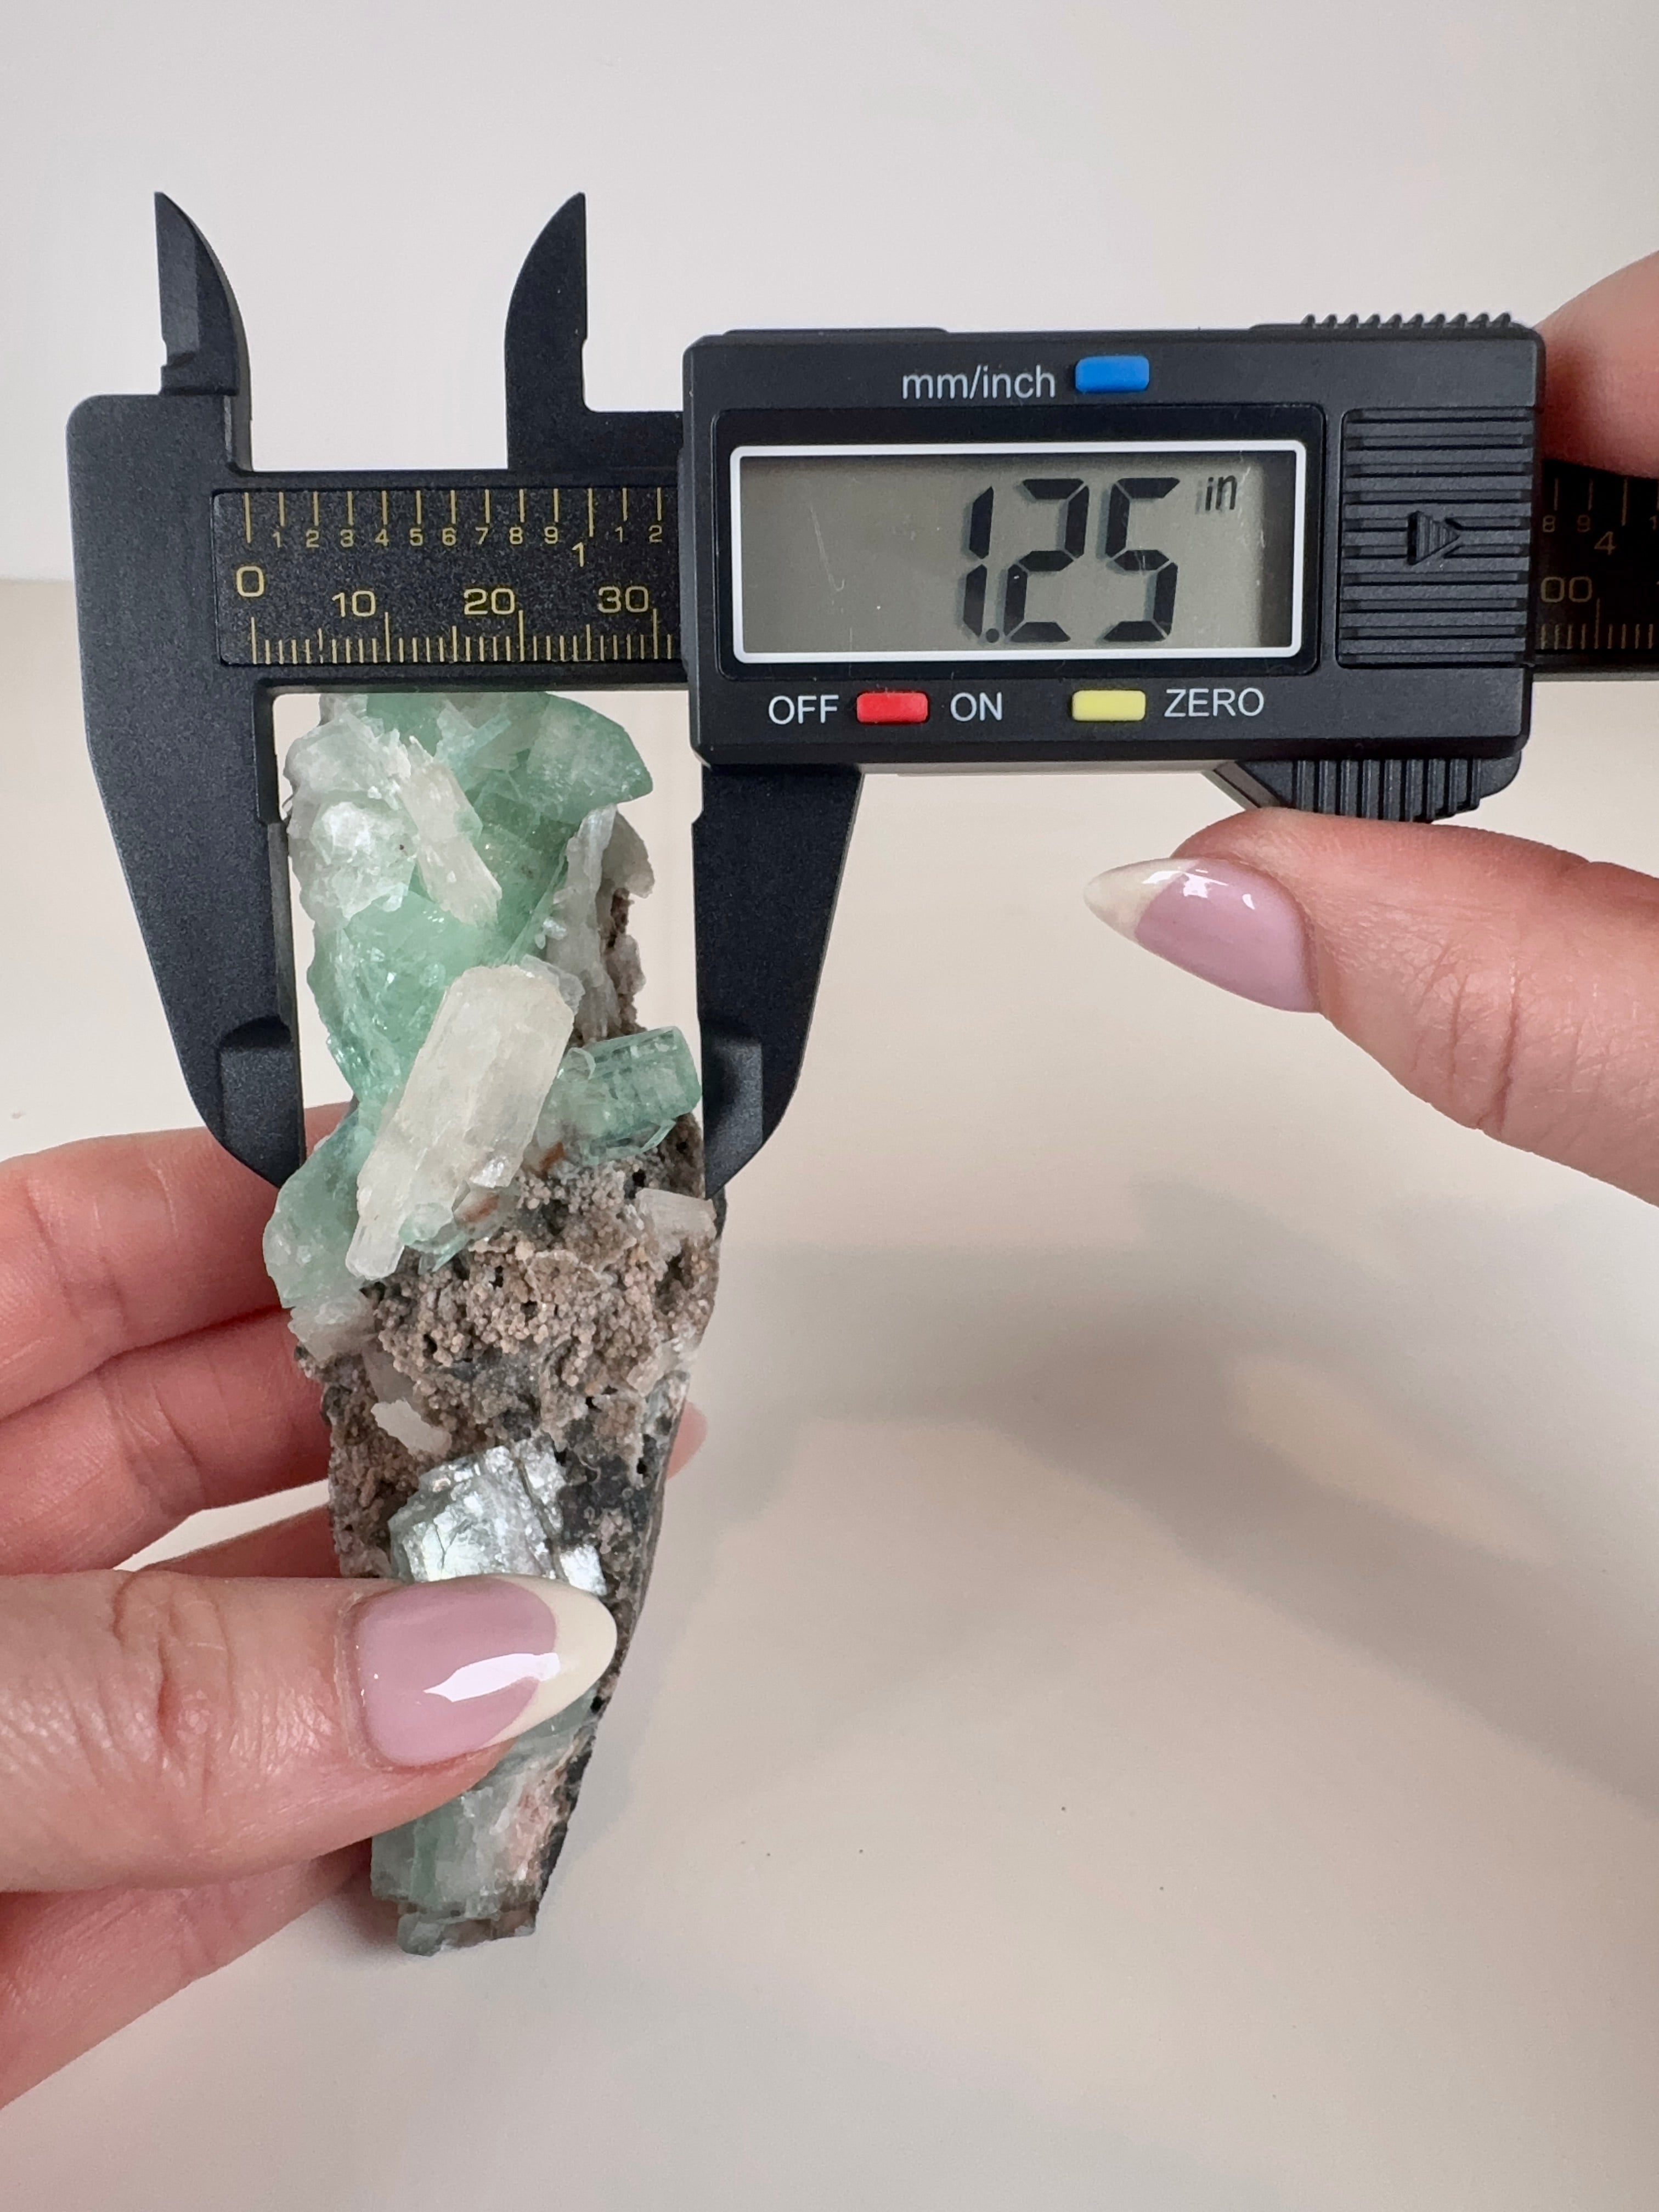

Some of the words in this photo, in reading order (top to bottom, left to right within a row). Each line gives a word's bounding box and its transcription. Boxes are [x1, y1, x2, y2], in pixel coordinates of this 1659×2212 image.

[901, 363, 1056, 400] mm/inch
[273, 532, 281, 548] 1
[306, 529, 320, 548] 2
[340, 529, 354, 548] 3
[375, 529, 390, 546] 4
[409, 528, 424, 546] 5
[442, 527, 456, 546] 6
[475, 527, 489, 545] 7
[509, 526, 523, 545] 8
[544, 526, 558, 544] 9
[572, 541, 585, 567] 1
[615, 526, 623, 543] 1
[648, 524, 662, 543] 2
[1542, 515, 1556, 533] 8
[1594, 531, 1617, 555] 4
[964, 477, 1181, 642] 1.25
[1203, 471, 1238, 512] in
[236, 565, 265, 597] 0
[331, 590, 376, 618] 10
[463, 588, 516, 615] 20
[597, 585, 649, 613] 30
[1540, 576, 1593, 603] 00
[768, 694, 839, 725] OFF
[950, 691, 1003, 721] ON
[1164, 687, 1265, 718] ZERO
